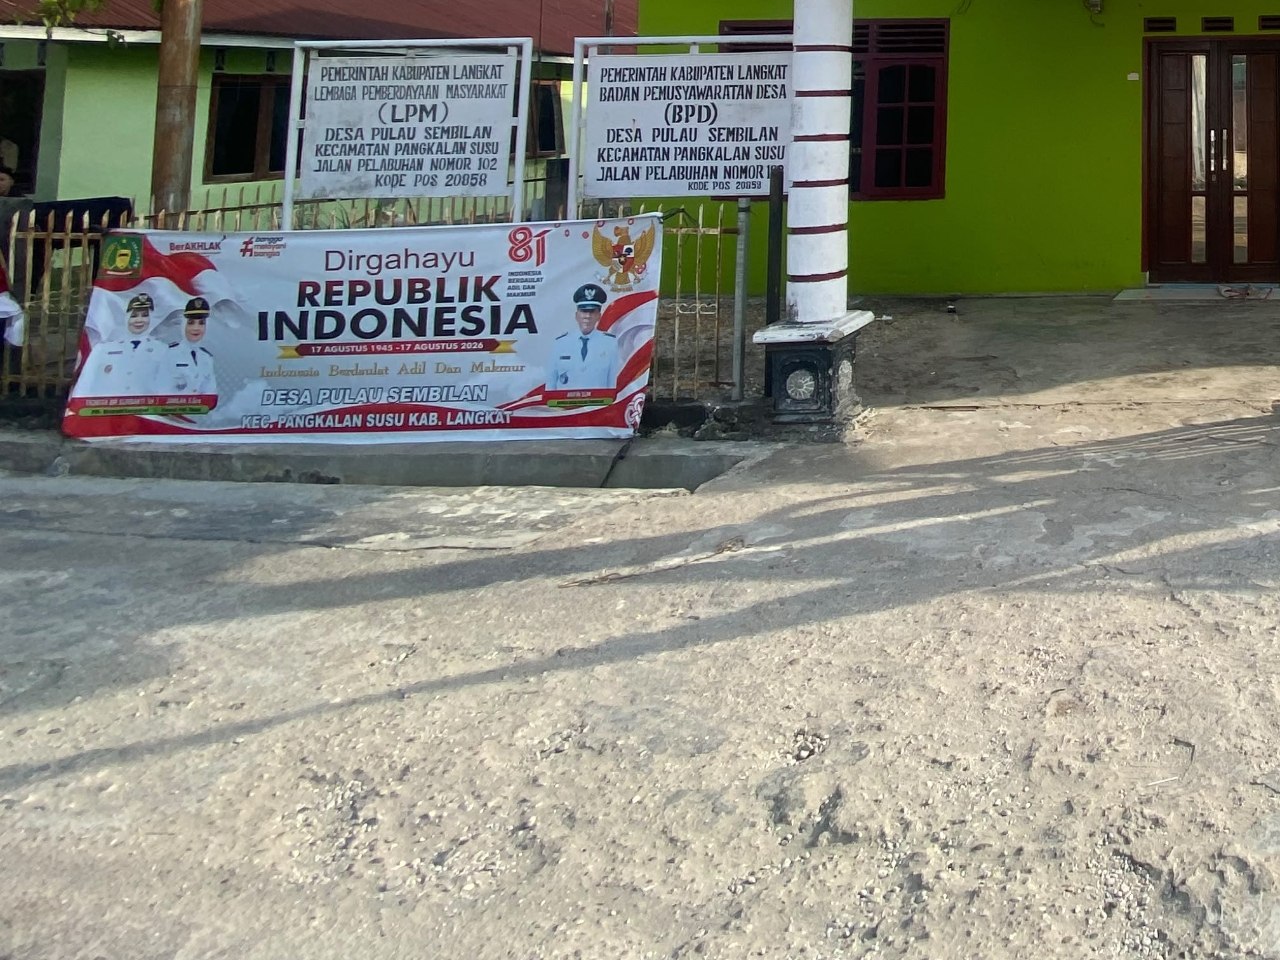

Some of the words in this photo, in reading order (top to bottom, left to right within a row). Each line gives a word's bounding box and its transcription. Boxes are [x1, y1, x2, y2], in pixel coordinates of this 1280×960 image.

[321, 66, 388, 81] PEMERINTAH
[392, 65, 449, 80] KABUPATEN
[453, 65, 504, 79] LANGKAT
[601, 67, 666, 82] PEMERINTAH
[671, 66, 733, 81] KABUPATEN
[738, 65, 788, 80] LANGKAT
[315, 86, 357, 100] LEMBAGA
[362, 85, 438, 100] PEMBERDAYAAN
[446, 84, 508, 98] MASYARAKAT
[600, 87, 639, 101] BADAN
[644, 85, 752, 101] PEMUSYAWARATAN
[756, 84, 786, 99] DESA
[664, 102, 718, 125] (BPD)
[325, 128, 364, 141] DESA
[372, 127, 416, 140] PULAU
[425, 126, 492, 139] SEMBILAN
[607, 128, 642, 143] DESA
[652, 128, 697, 142] PULAU
[708, 127, 778, 141] SEMBILAN
[315, 143, 389, 156] KECAMATAN
[395, 142, 466, 155] PANGKALAN
[470, 142, 498, 154] SUSU
[597, 147, 669, 162] KECAMATAN
[674, 146, 750, 161] PANGKALAN
[755, 145, 785, 160] SUSU
[314, 159, 351, 172] JALAN
[358, 158, 423, 171] PELABUHAN
[430, 158, 471, 171] NOMOR
[478, 158, 497, 170] 102
[597, 167, 640, 181] JALAN
[646, 166, 717, 180] PELABUHAN
[724, 165, 763, 179] NOMOR
[375, 174, 405, 187] KODE
[414, 174, 438, 186] POS
[688, 182, 708, 190] KODE
[713, 182, 730, 190] POS
[170, 242, 220, 250] BerAKHLAK
[508, 226, 552, 267] 81
[325, 248, 475, 275] Dirgahayu
[297, 275, 502, 308] REPUBLIK
[258, 304, 538, 341] INDONESIA
[260, 366, 319, 377] Indonesia
[328, 363, 389, 376] Berdaulat
[397, 361, 426, 374] Adil
[435, 362, 461, 373] Dan
[470, 360, 526, 373] Makmur
[261, 389, 312, 405] DESA
[317, 387, 383, 404] PULAU
[387, 385, 488, 403] SEMBILAN
[241, 415, 273, 428] KEC.
[278, 414, 362, 428] PANGKALAN
[366, 413, 404, 427] SUSU
[409, 412, 442, 426] KAB.
[446, 410, 513, 425] LANGKAT
